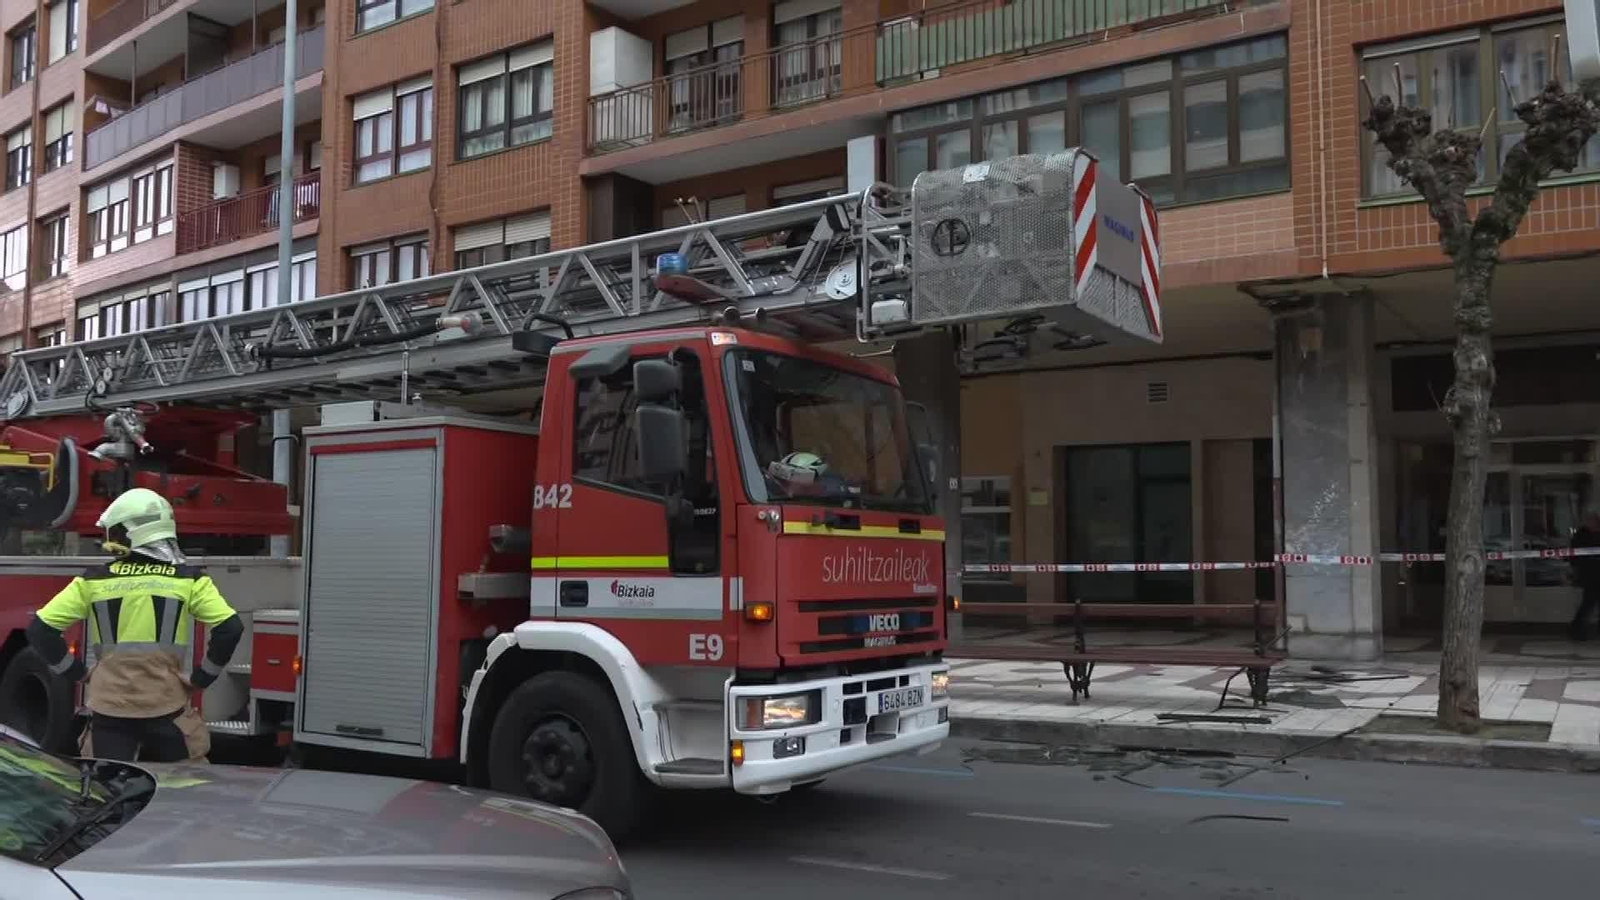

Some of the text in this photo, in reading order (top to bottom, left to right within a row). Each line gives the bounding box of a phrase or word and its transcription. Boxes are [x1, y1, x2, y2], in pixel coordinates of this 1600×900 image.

[119, 563, 176, 575] Bizkaia
[822, 546, 929, 583] suhiltzaileak
[617, 584, 655, 598] Bizkaia
[689, 633, 724, 661] E9
[884, 689, 923, 711] 6484 BZN
